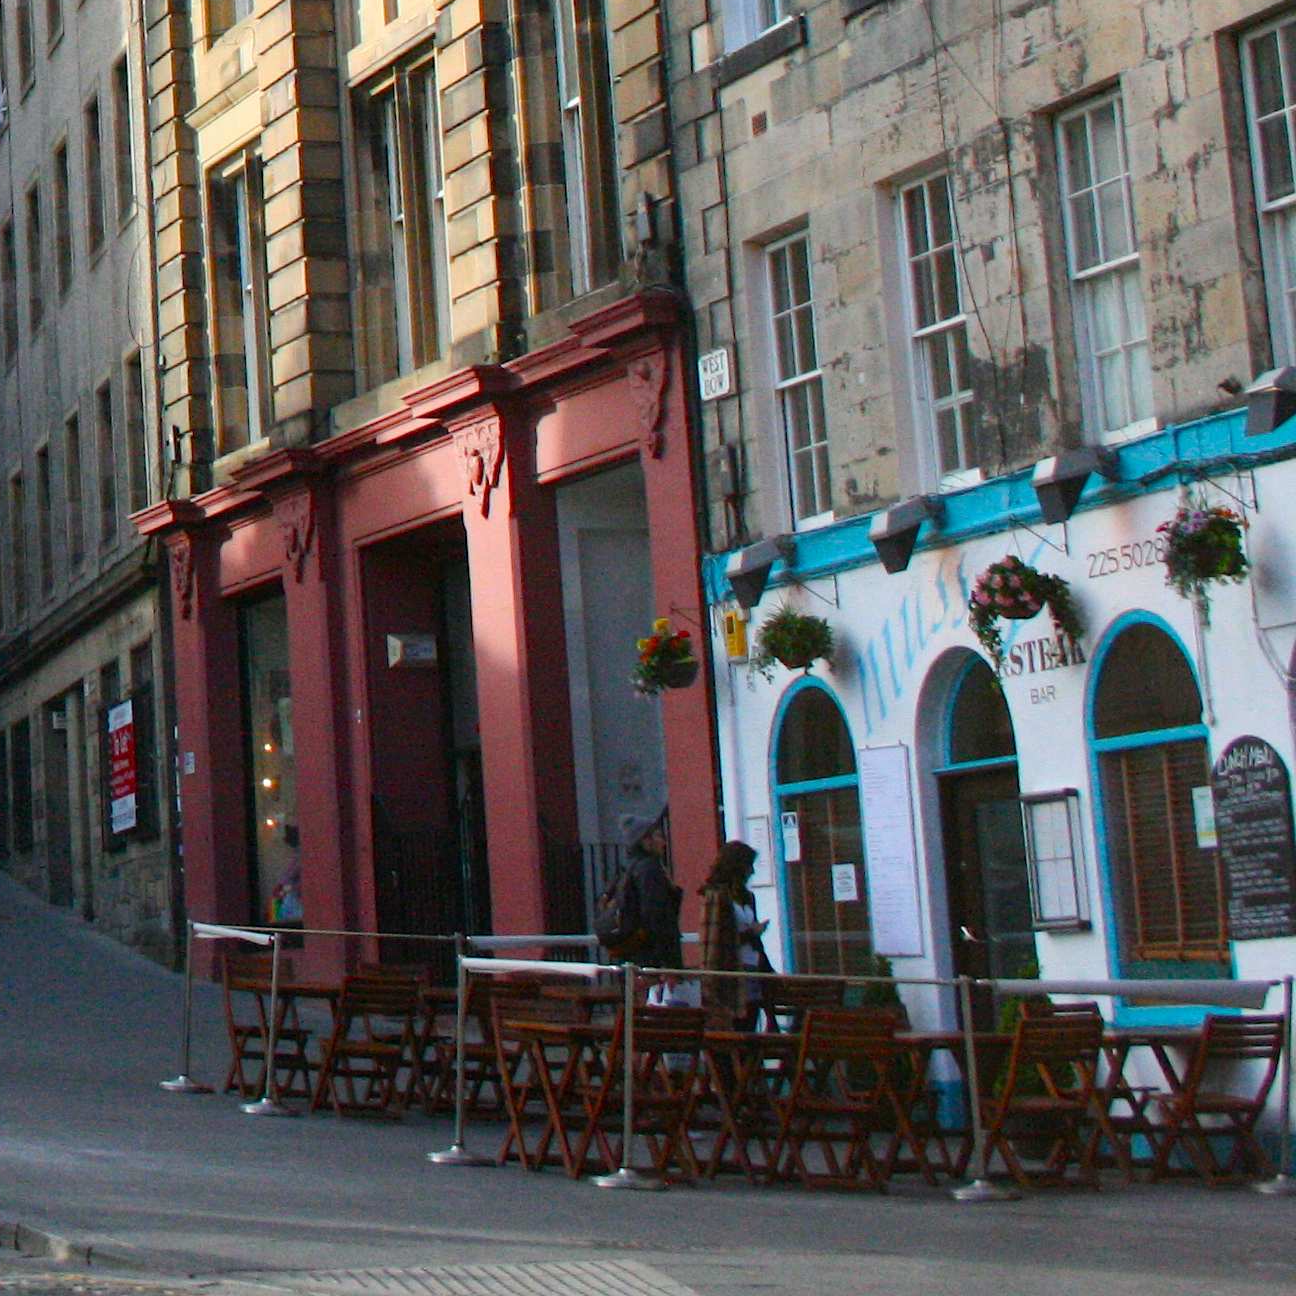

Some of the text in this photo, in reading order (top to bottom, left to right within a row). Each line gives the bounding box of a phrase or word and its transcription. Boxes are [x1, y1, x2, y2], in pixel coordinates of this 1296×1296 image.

[703, 351, 725, 374] WEST
[704, 375, 724, 396] BOW
[1029, 685, 1057, 705] BAR
[1216, 745, 1248, 776] LUNCH
